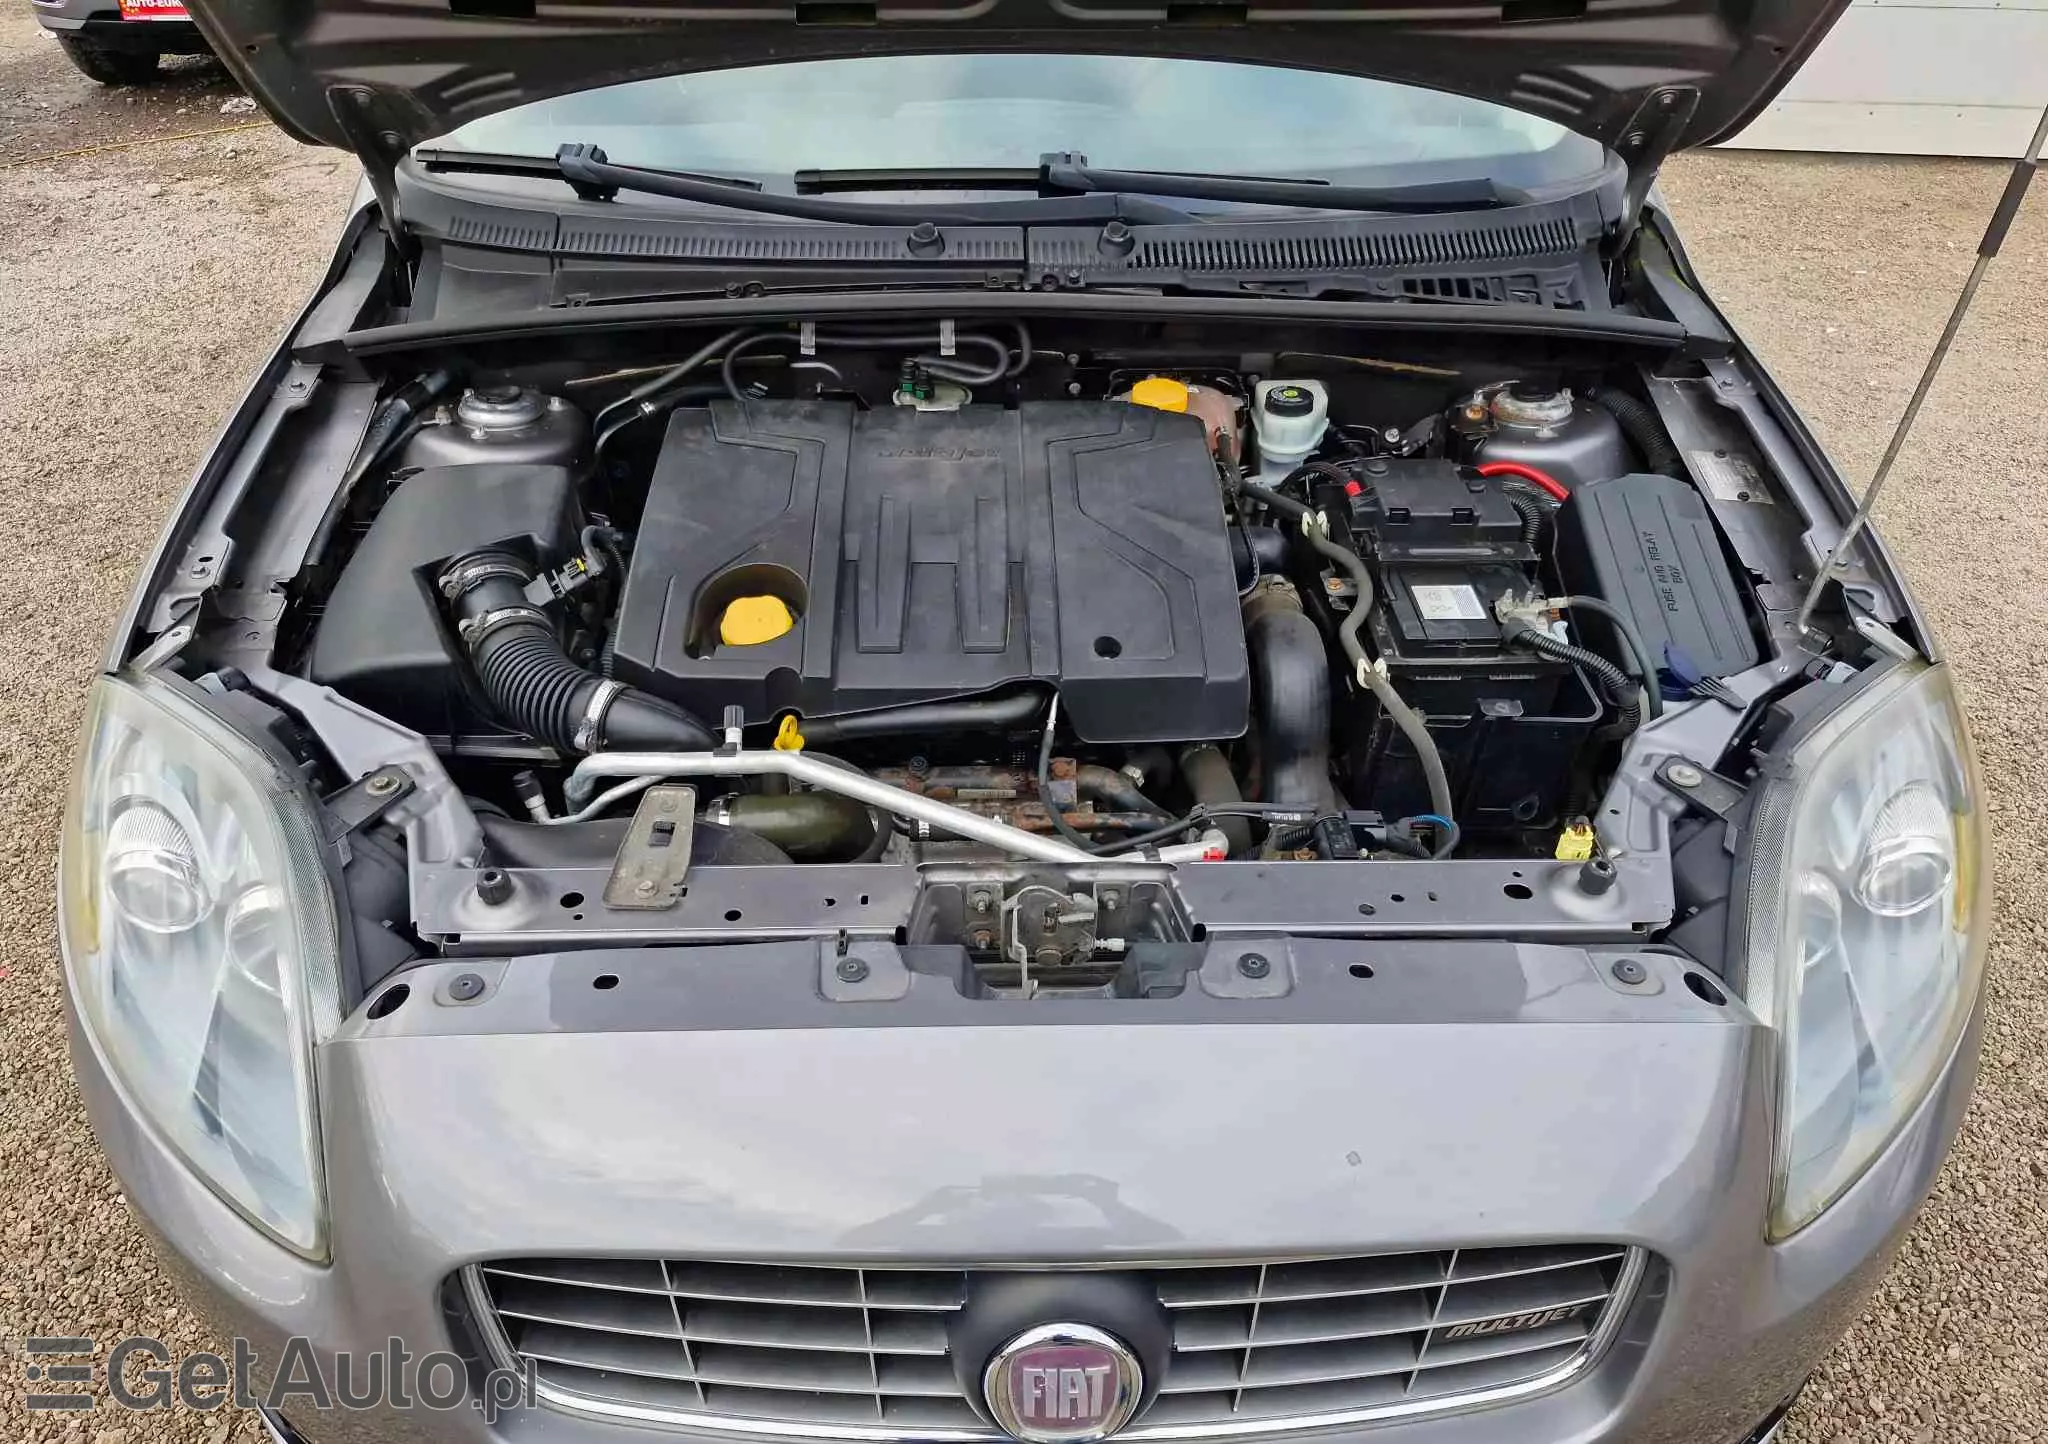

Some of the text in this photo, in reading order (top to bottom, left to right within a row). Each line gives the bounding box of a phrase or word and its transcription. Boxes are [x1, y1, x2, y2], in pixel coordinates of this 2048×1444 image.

[1642, 531, 1678, 611] FUSE AND RELAY
[1668, 565, 1683, 583] BOX
[1445, 1304, 1591, 1338] MULTIJET
[1023, 1365, 1111, 1418] FIAT
